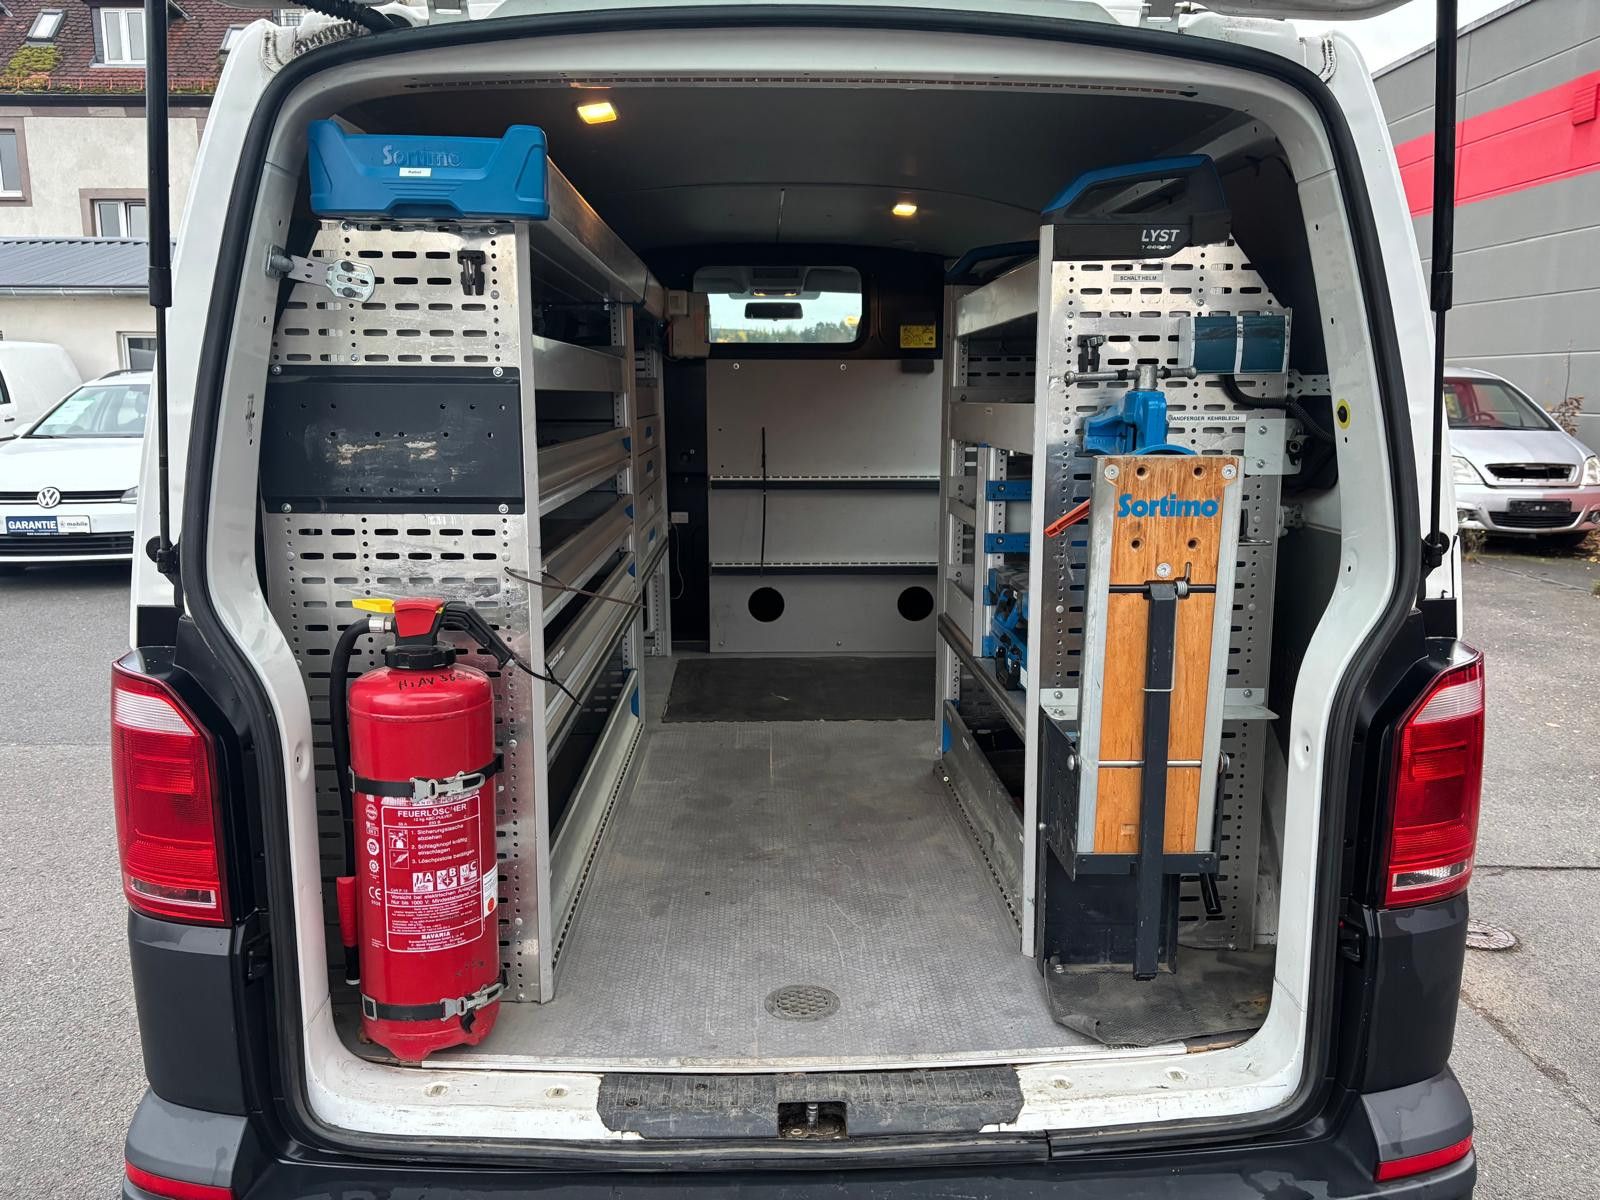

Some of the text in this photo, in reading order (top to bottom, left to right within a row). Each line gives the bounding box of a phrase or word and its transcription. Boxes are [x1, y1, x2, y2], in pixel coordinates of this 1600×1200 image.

[1141, 229, 1180, 242] LYST
[1117, 493, 1219, 518] Sortimo
[8, 520, 57, 530] GARANTIE
[470, 861, 477, 870] C
[424, 873, 433, 881] A
[449, 867, 457, 877] B
[421, 931, 451, 940] BAVARIA
